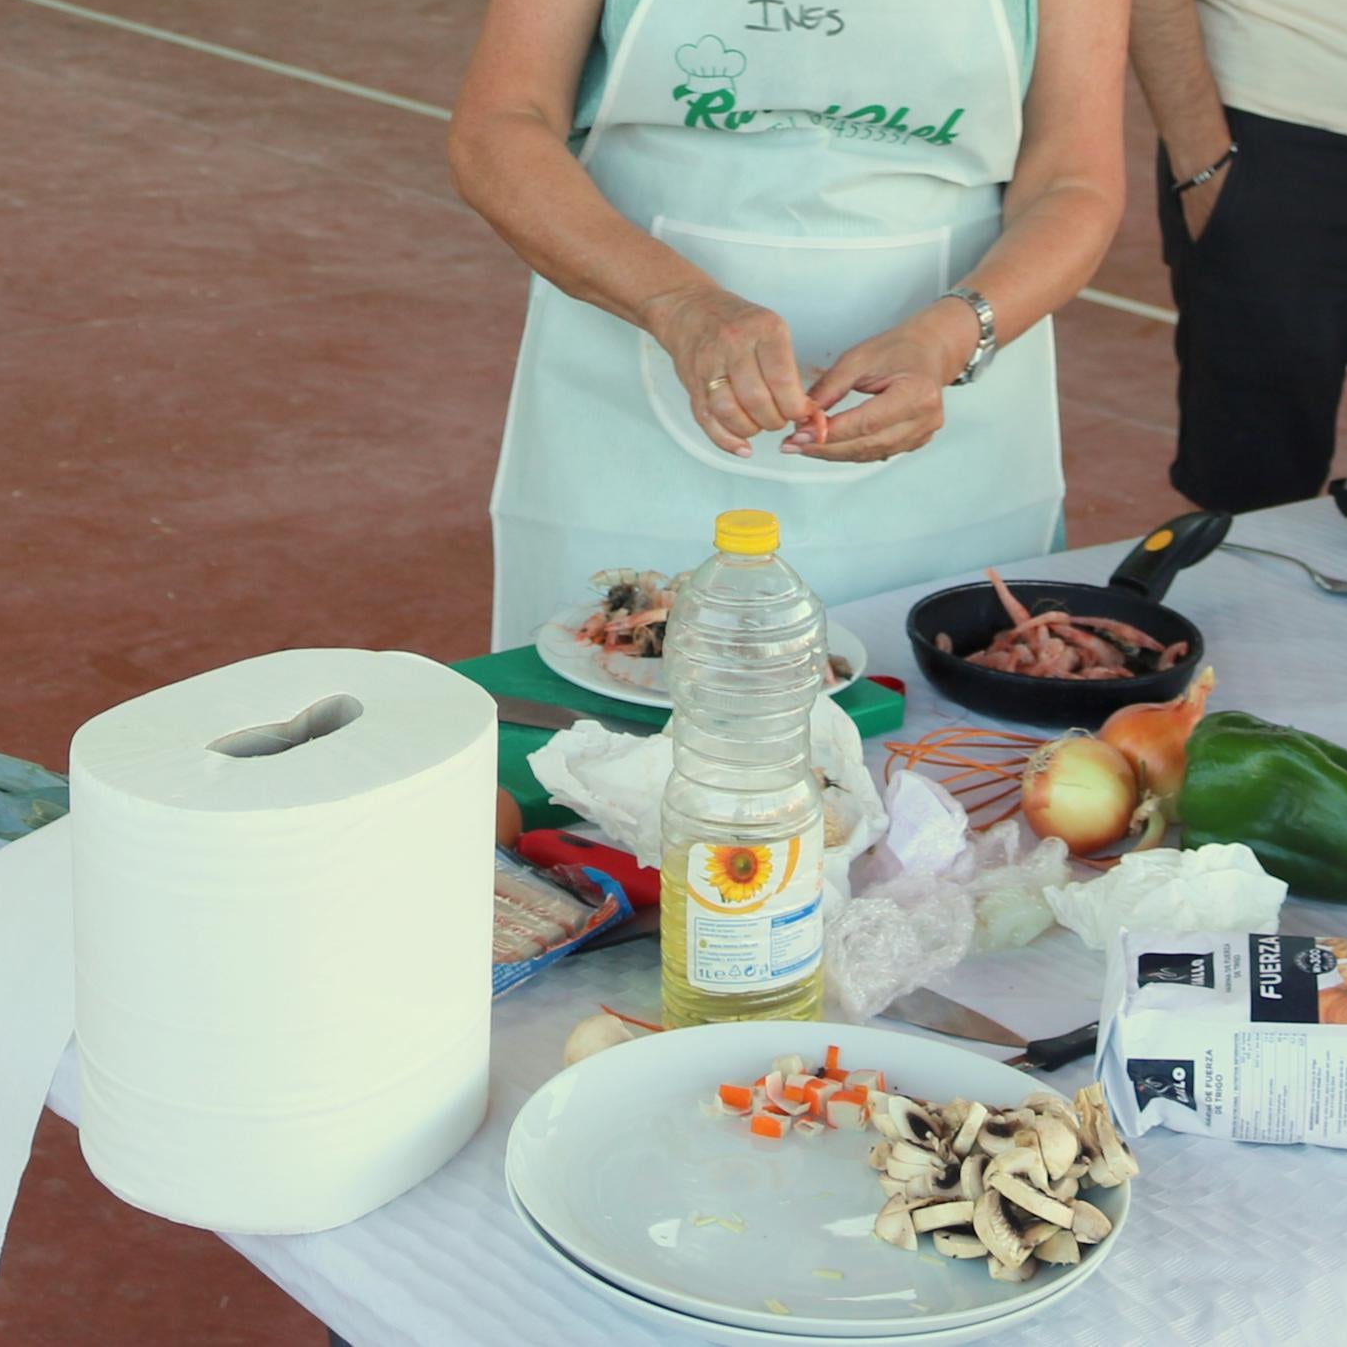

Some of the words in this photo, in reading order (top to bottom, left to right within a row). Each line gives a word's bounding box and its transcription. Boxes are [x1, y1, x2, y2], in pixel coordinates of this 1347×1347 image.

[1258, 935, 1283, 1000] FUERZA
[1203, 1048, 1213, 1089] FUERZA
[1214, 1073, 1223, 1103] TRIGO
